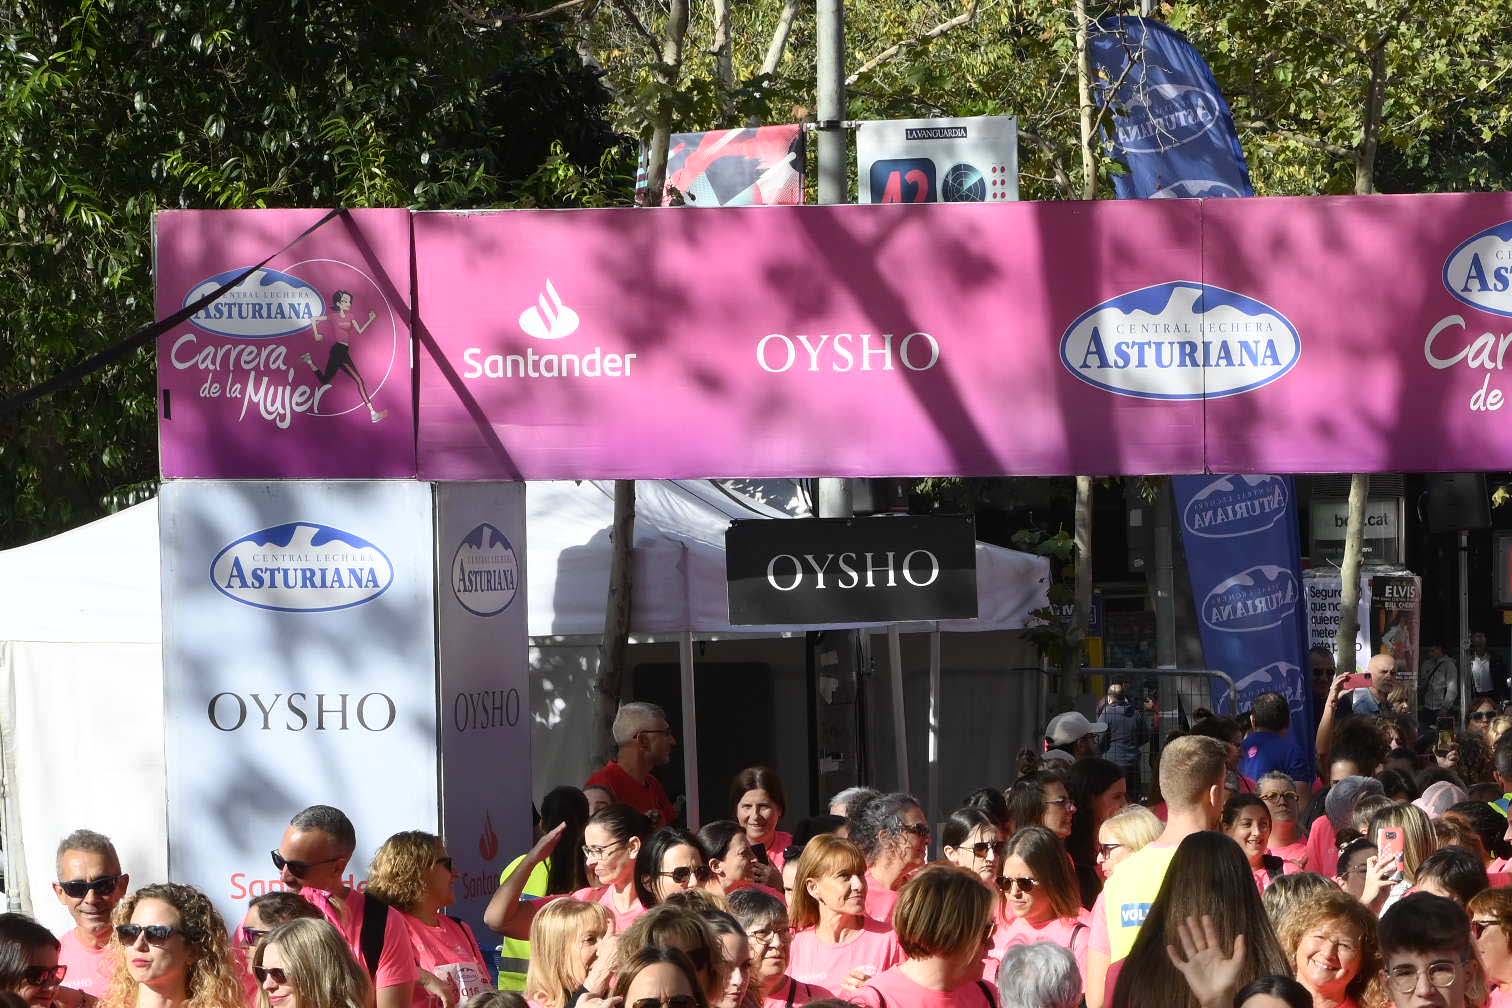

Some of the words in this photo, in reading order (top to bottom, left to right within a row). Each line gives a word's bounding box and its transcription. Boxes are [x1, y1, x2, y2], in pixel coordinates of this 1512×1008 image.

[194, 293, 313, 320] ASTURIANA
[222, 291, 259, 299] ENTRAL
[1116, 322, 1191, 335] CENTRAL
[1200, 321, 1274, 334] LECHERA
[171, 333, 288, 371] Carrera
[464, 347, 636, 377] Santander
[756, 332, 940, 373] OYSHO
[1080, 326, 1282, 369] ASTURIANA
[200, 372, 221, 398] de
[226, 372, 241, 398] la
[239, 368, 332, 428] Mujer
[1470, 370, 1503, 413] de
[225, 555, 380, 590] ASTURIANA
[253, 553, 309, 563] CENTRAL
[316, 553, 374, 563] LECHERA
[458, 558, 514, 592] ASTURIANA
[768, 550, 939, 591] OYSHO
[1311, 602, 1327, 612] que
[1385, 586, 1415, 598] ELVIS
[207, 692, 397, 732] OYSHO
[455, 688, 520, 732] OYSHO
[1121, 908, 1149, 921] VOL
